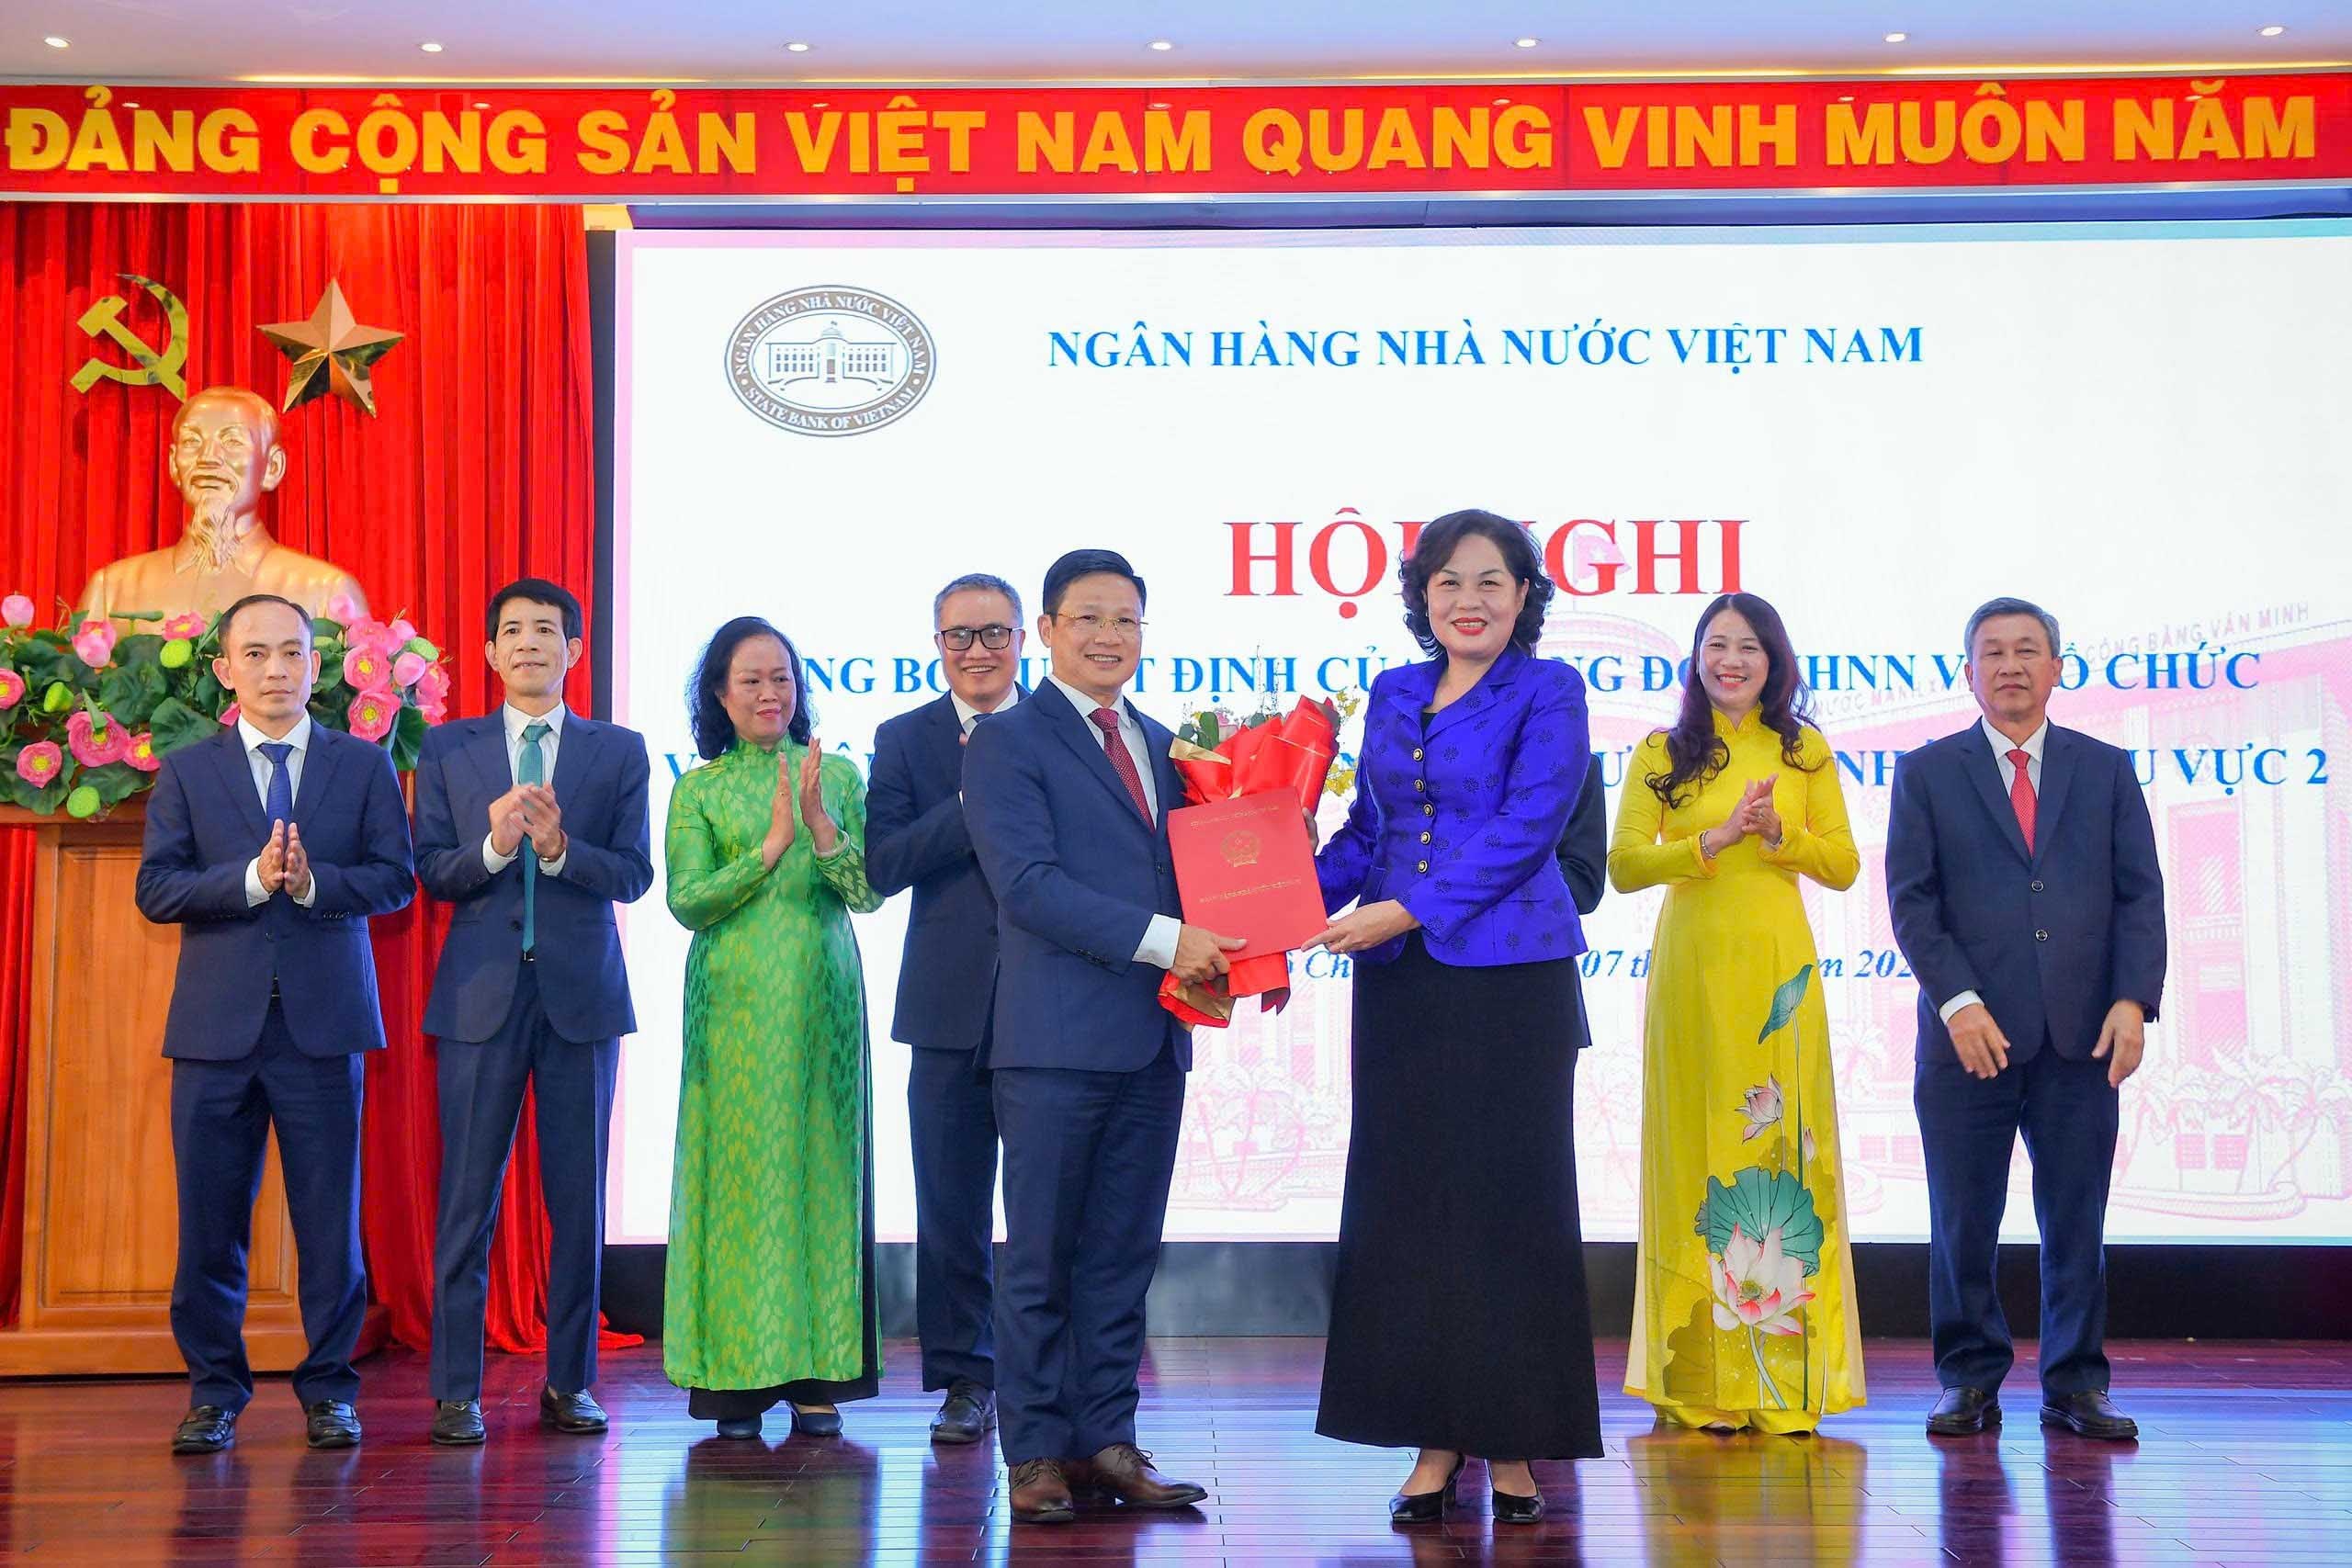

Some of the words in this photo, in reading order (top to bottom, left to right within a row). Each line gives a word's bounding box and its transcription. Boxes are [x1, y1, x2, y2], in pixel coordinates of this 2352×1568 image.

[4, 84, 260, 173] ĐẢNG
[289, 92, 548, 194] CỘNG
[577, 87, 757, 174] SẢN
[785, 95, 986, 192] VIỆT
[1017, 110, 1212, 173] NAM
[1242, 105, 1553, 176] QUANG
[1583, 104, 1797, 168] VINH
[1826, 83, 2086, 164] MUÔN
[2113, 80, 2315, 160] NĂM
[1048, 320, 1193, 368] NGÂN
[1210, 320, 1360, 367] HÀNG
[1377, 319, 1487, 366] NHÀ
[1501, 318, 1651, 366] NƯỚC
[1666, 321, 1788, 375] VIỆT
[1804, 326, 1924, 364] NAM
[745, 387, 789, 420] STATE
[788, 412, 829, 429] BANK
[831, 415, 853, 430] OF
[802, 658, 876, 694] NG
[1169, 657, 1297, 703] ĐỊNH
[1317, 646, 1412, 694] CỦ
[1796, 654, 1917, 691] HNN
[2105, 641, 2261, 690] CHỨC
[2171, 742, 2288, 795] VỰC
[2306, 748, 2329, 785] 2
[1306, 950, 1351, 978] Ch
[1581, 950, 1624, 977] 07
